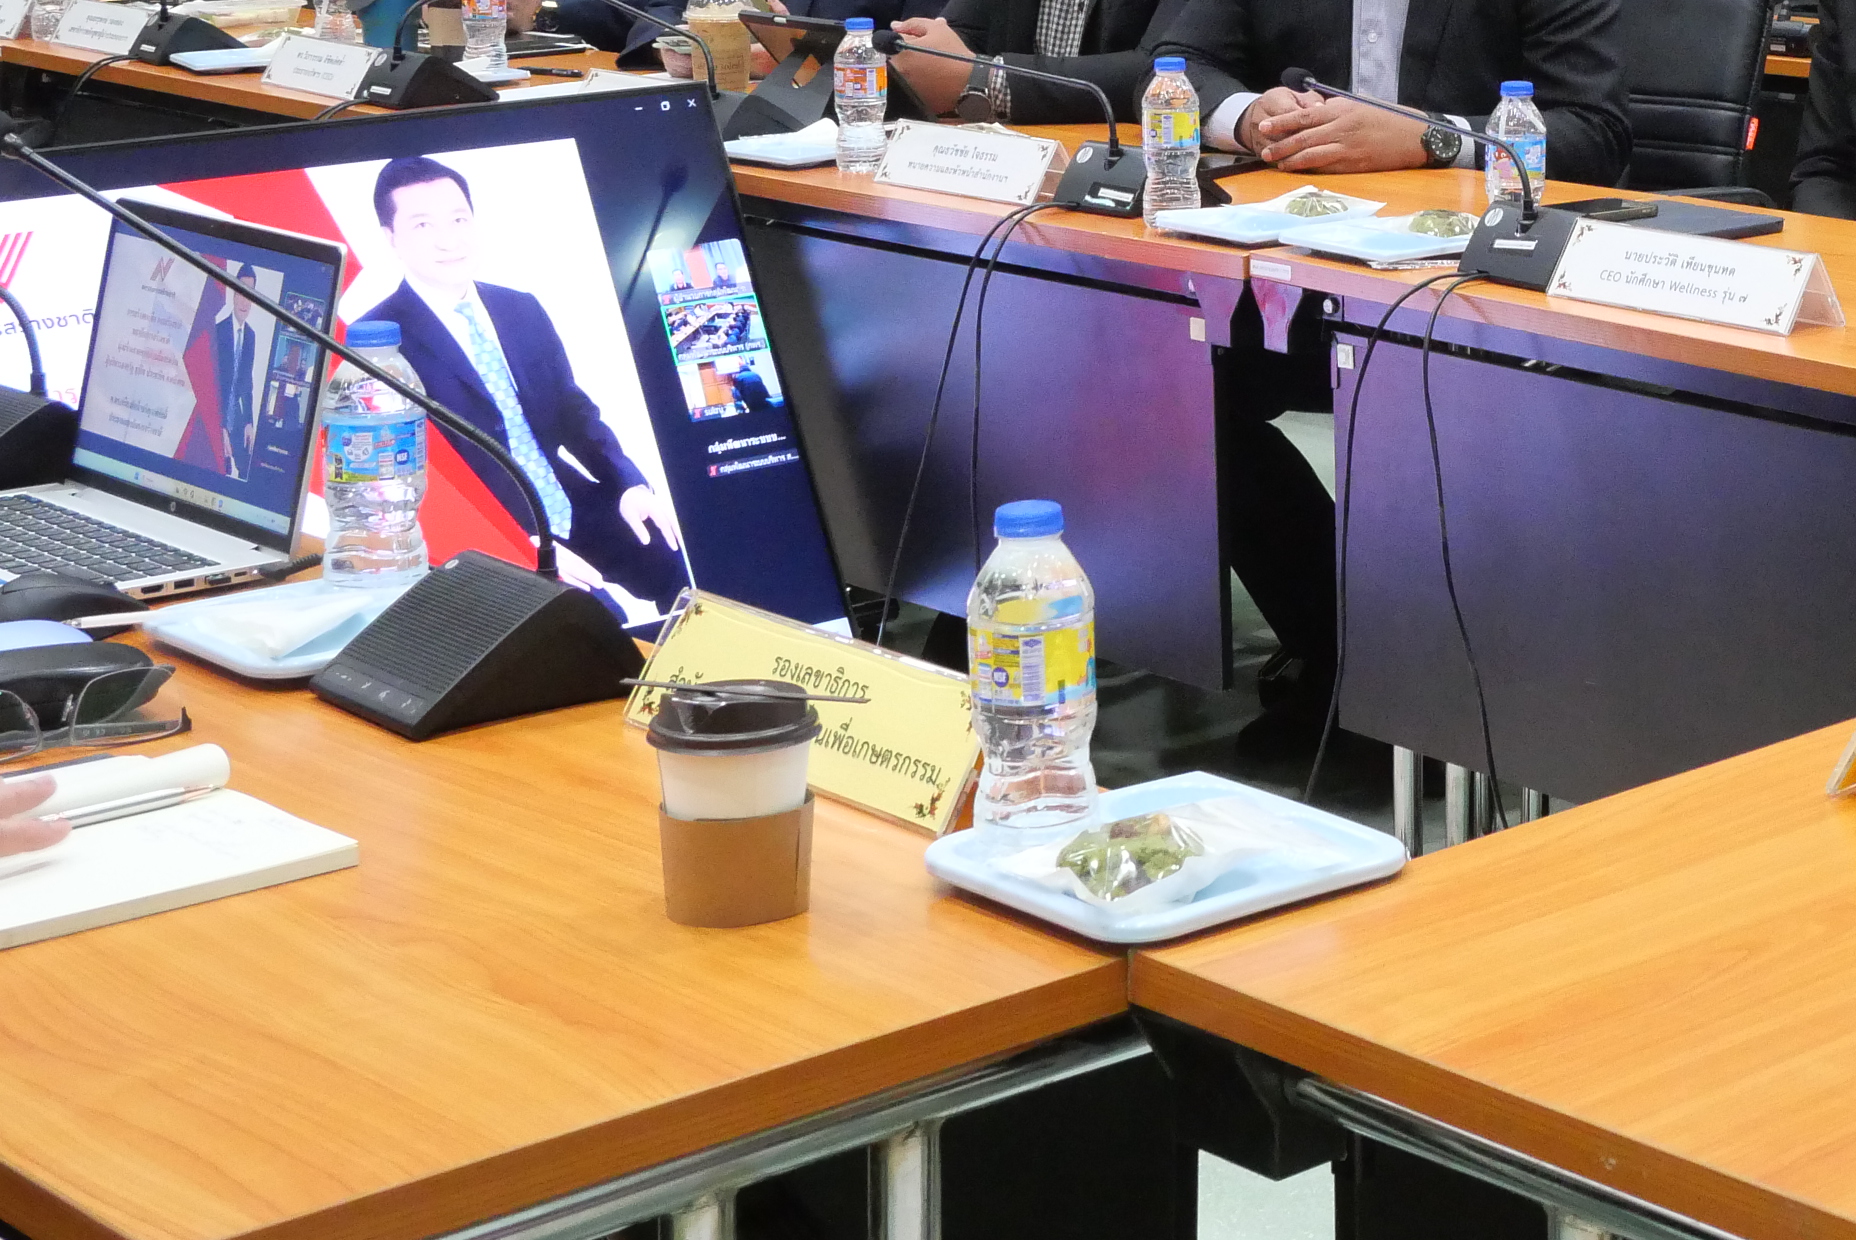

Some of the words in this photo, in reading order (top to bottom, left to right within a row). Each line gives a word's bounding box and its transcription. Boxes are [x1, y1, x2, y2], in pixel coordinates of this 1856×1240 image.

[1599, 269, 1622, 282] CEO
[1625, 270, 1665, 289] นักศึกษา
[1669, 280, 1718, 299] Wellness
[1722, 287, 1736, 304] รุ่น
[772, 656, 869, 698] รองเลขาธิการ
